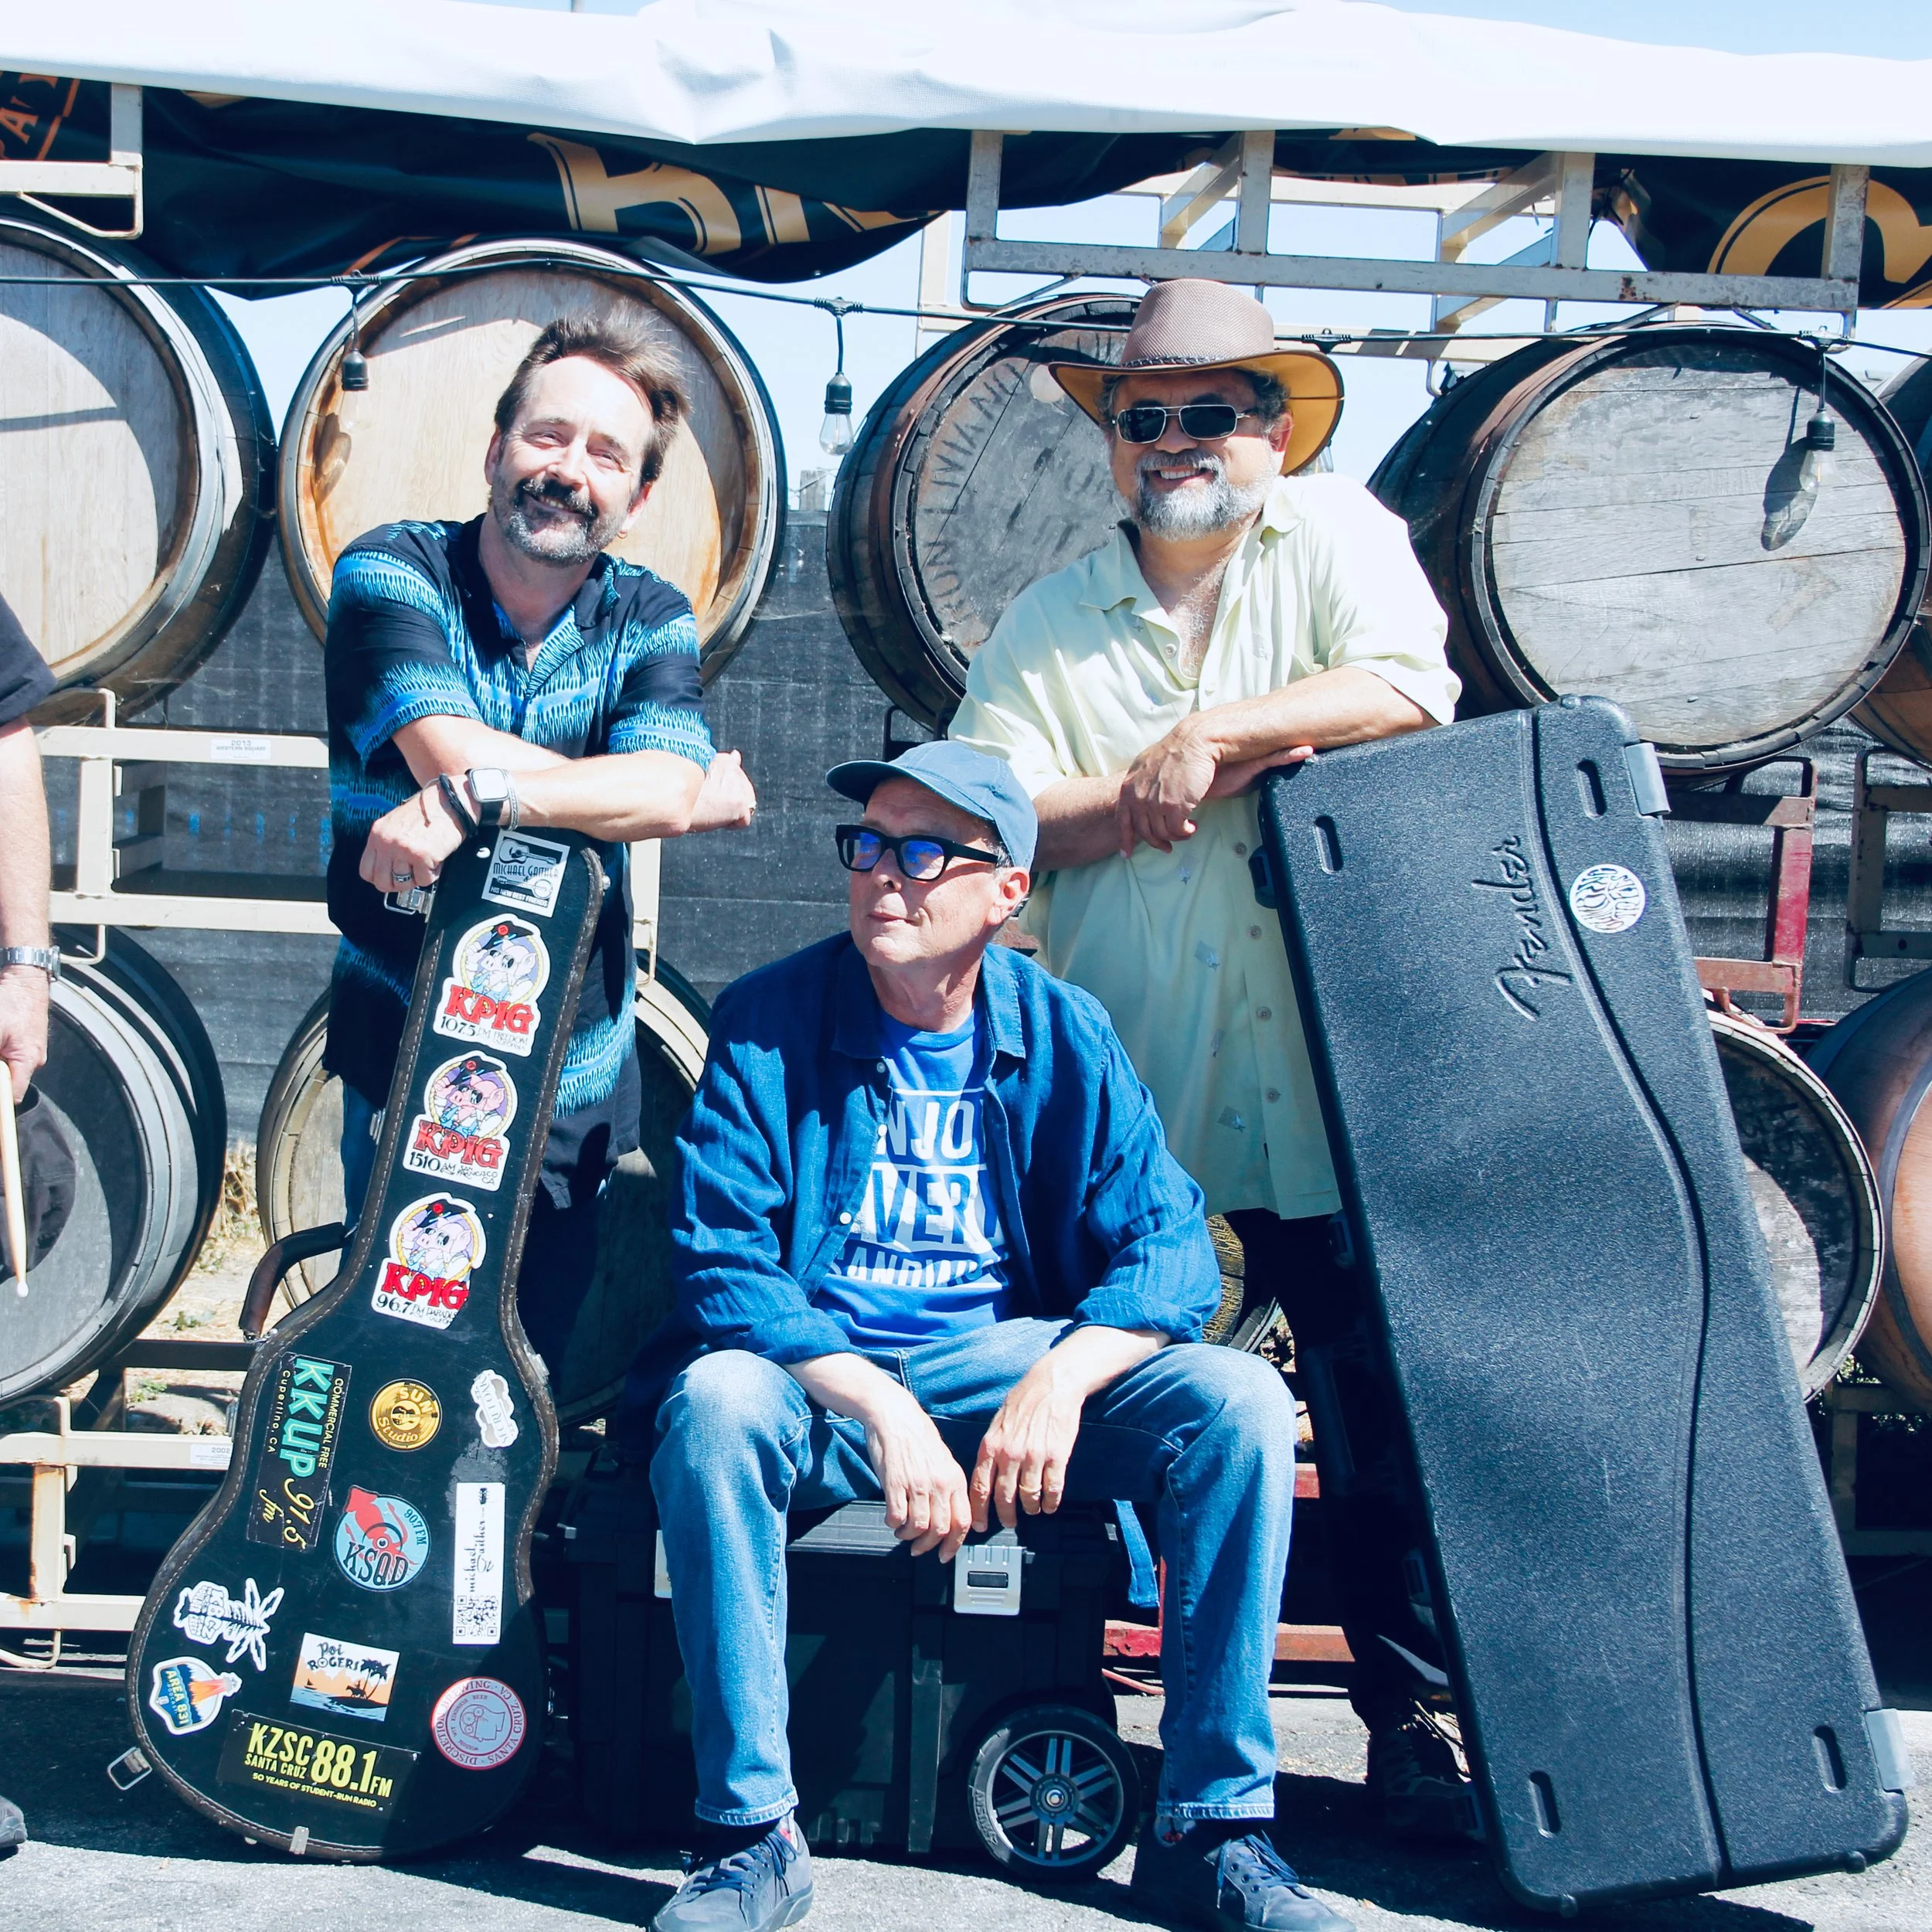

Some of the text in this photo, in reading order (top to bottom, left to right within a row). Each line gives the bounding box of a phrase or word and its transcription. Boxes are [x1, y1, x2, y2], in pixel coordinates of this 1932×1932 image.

[493, 862, 559, 878] MICHAEL GAITHER
[1471, 835, 1573, 1022] Fender
[444, 985, 534, 1035] KPIG
[413, 1120, 503, 1169] KPIG
[876, 1099, 986, 1159] NJO
[410, 1151, 440, 1172] 1510
[376, 1294, 413, 1315] 96.7
[381, 1262, 470, 1311] KPIG
[399, 1386, 434, 1413] SUN
[318, 1378, 345, 1469] COMMERCIAL FREE
[377, 1417, 420, 1443] Studio
[267, 1437, 278, 1453] CA
[279, 1358, 335, 1549] KKUP 91.5
[343, 1541, 409, 1587] KSQD
[464, 1547, 476, 1593] michael
[307, 1656, 359, 1672] ROGERS
[317, 1641, 345, 1659] Poi
[165, 1669, 190, 1725] AREA 831
[499, 1686, 512, 1700] CA
[435, 1713, 478, 1765] DISCRETION
[488, 1738, 519, 1764] SANTA
[244, 1752, 308, 1780] SANTA CRUZ
[247, 1722, 393, 1798] KZSC 88.1 FM
[252, 1772, 378, 1809] 50 YEARS OF STUDENT-RUN RADIO
